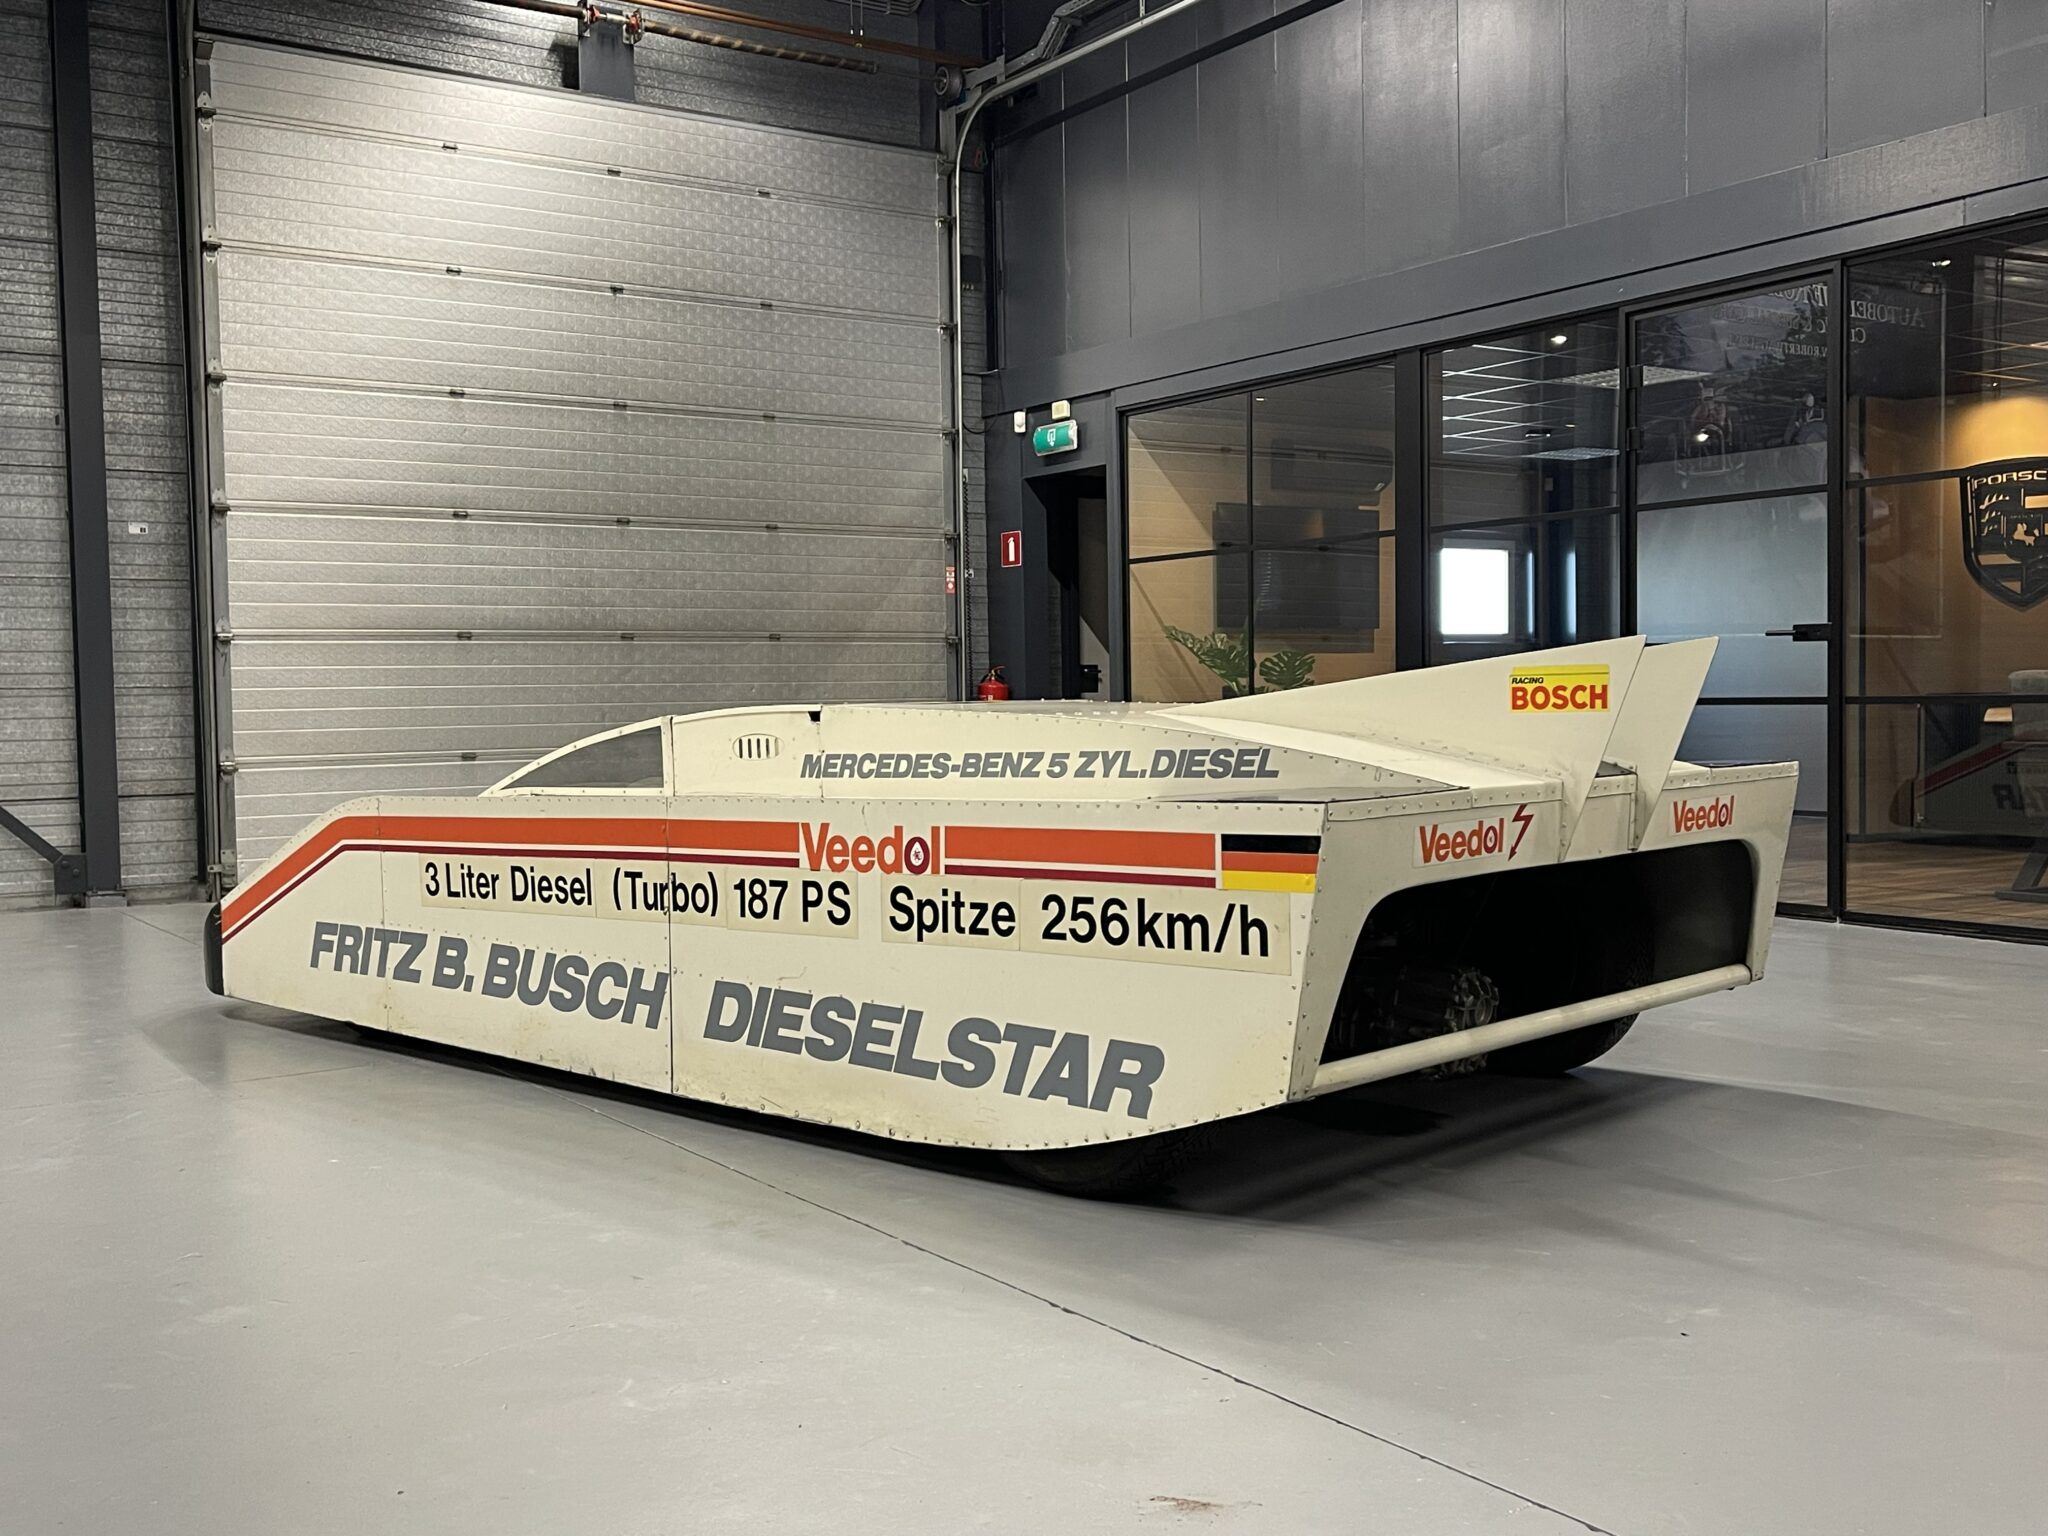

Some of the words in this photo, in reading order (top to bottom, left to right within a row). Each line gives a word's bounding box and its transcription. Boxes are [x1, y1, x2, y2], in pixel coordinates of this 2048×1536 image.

[1511, 677, 1544, 685] RACING
[1511, 684, 1608, 710] BOSCH
[800, 751, 1046, 779] MERCEDES-BENZ
[1046, 752, 1071, 779] 5
[1674, 795, 1735, 833] Veedol
[801, 822, 941, 875] Veedol
[1419, 817, 1505, 864] Veedol
[511, 865, 593, 906] Diesel
[612, 867, 719, 917] (Turbo)
[733, 878, 788, 920] 187
[802, 880, 852, 926] PS
[889, 885, 1017, 943] Spitze
[310, 921, 429, 984] FRITZ
[432, 935, 475, 993] B.
[482, 942, 670, 1030] BUSCH
[702, 979, 1165, 1121] DIESELSTAR
